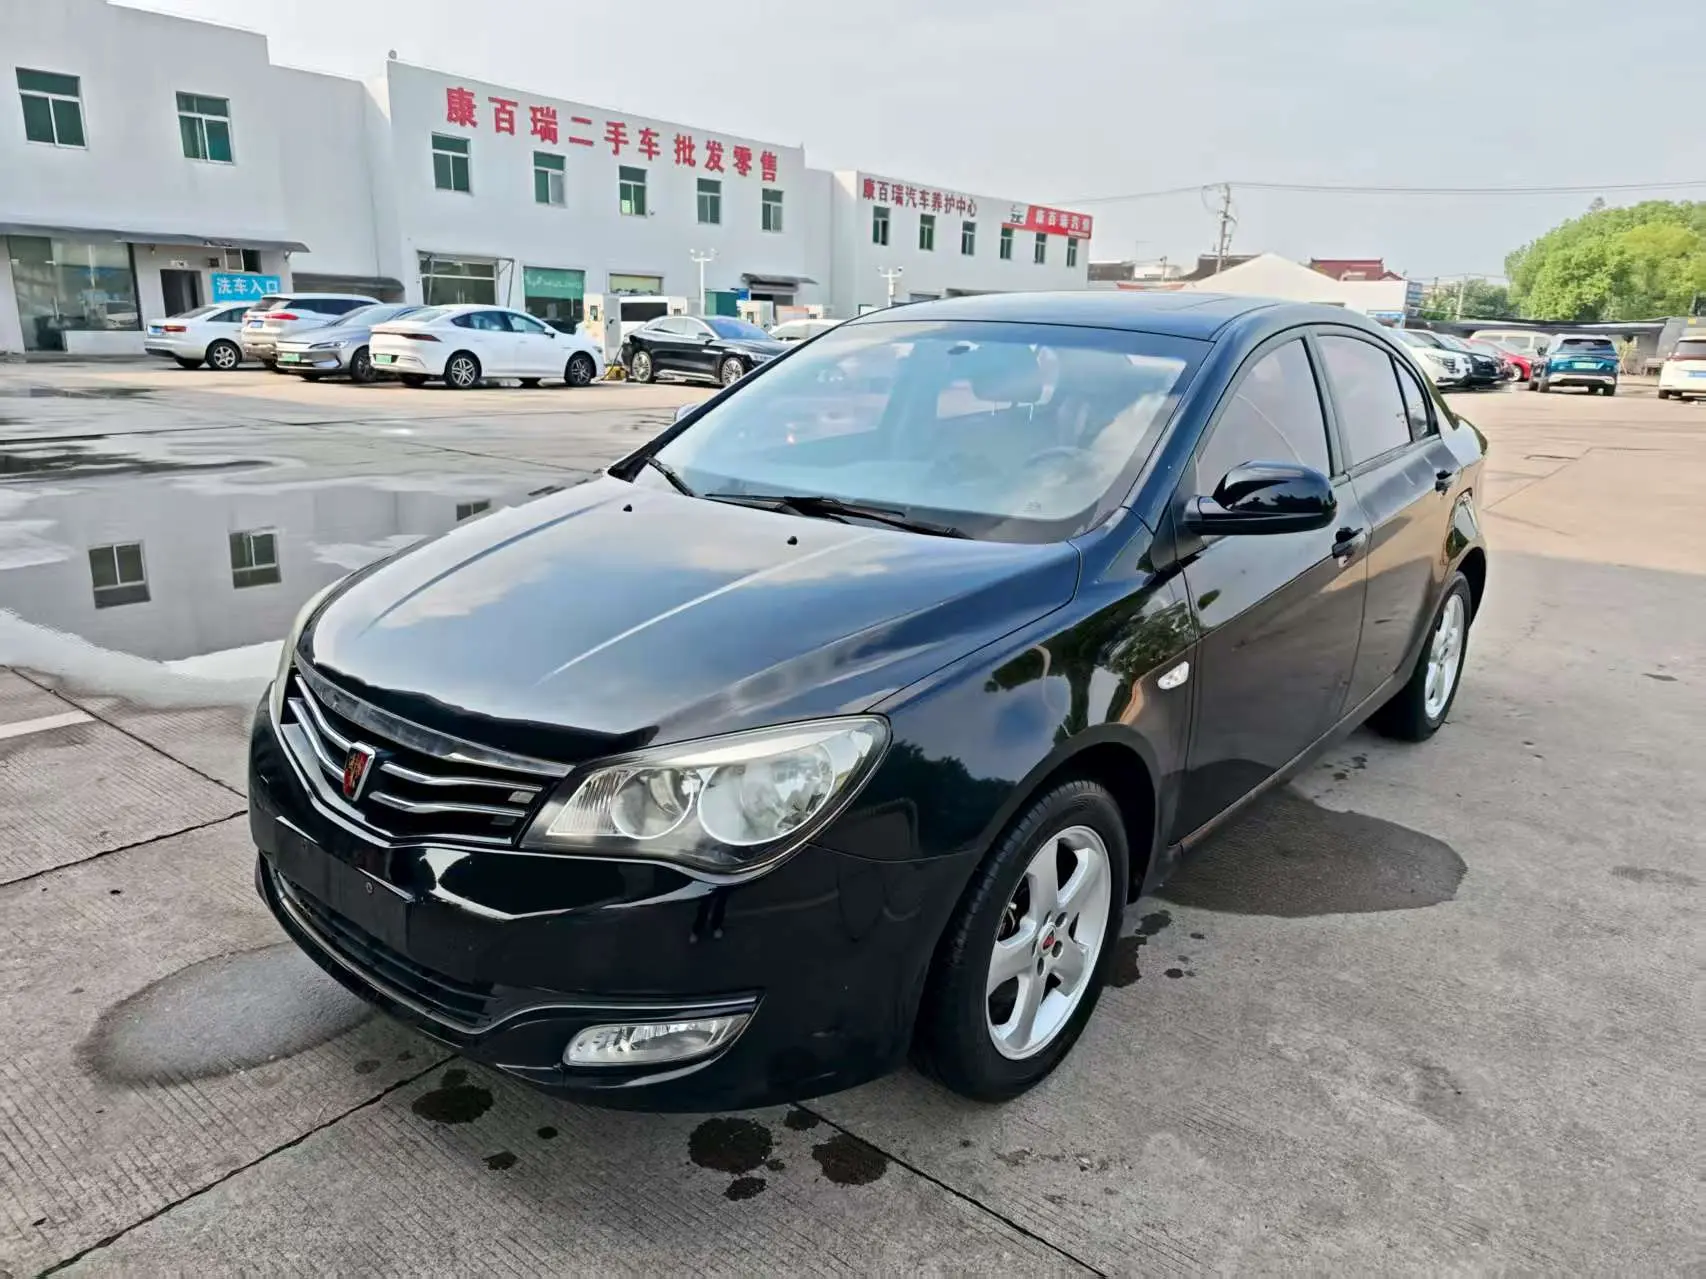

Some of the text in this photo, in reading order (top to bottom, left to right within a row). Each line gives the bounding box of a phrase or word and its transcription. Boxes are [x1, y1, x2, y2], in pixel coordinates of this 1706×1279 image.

[446, 87, 778, 182] 康百瑞二手车批发零售
[863, 178, 977, 217] 康百瑞汽车养护中心
[216, 277, 279, 295] 洗车入口
